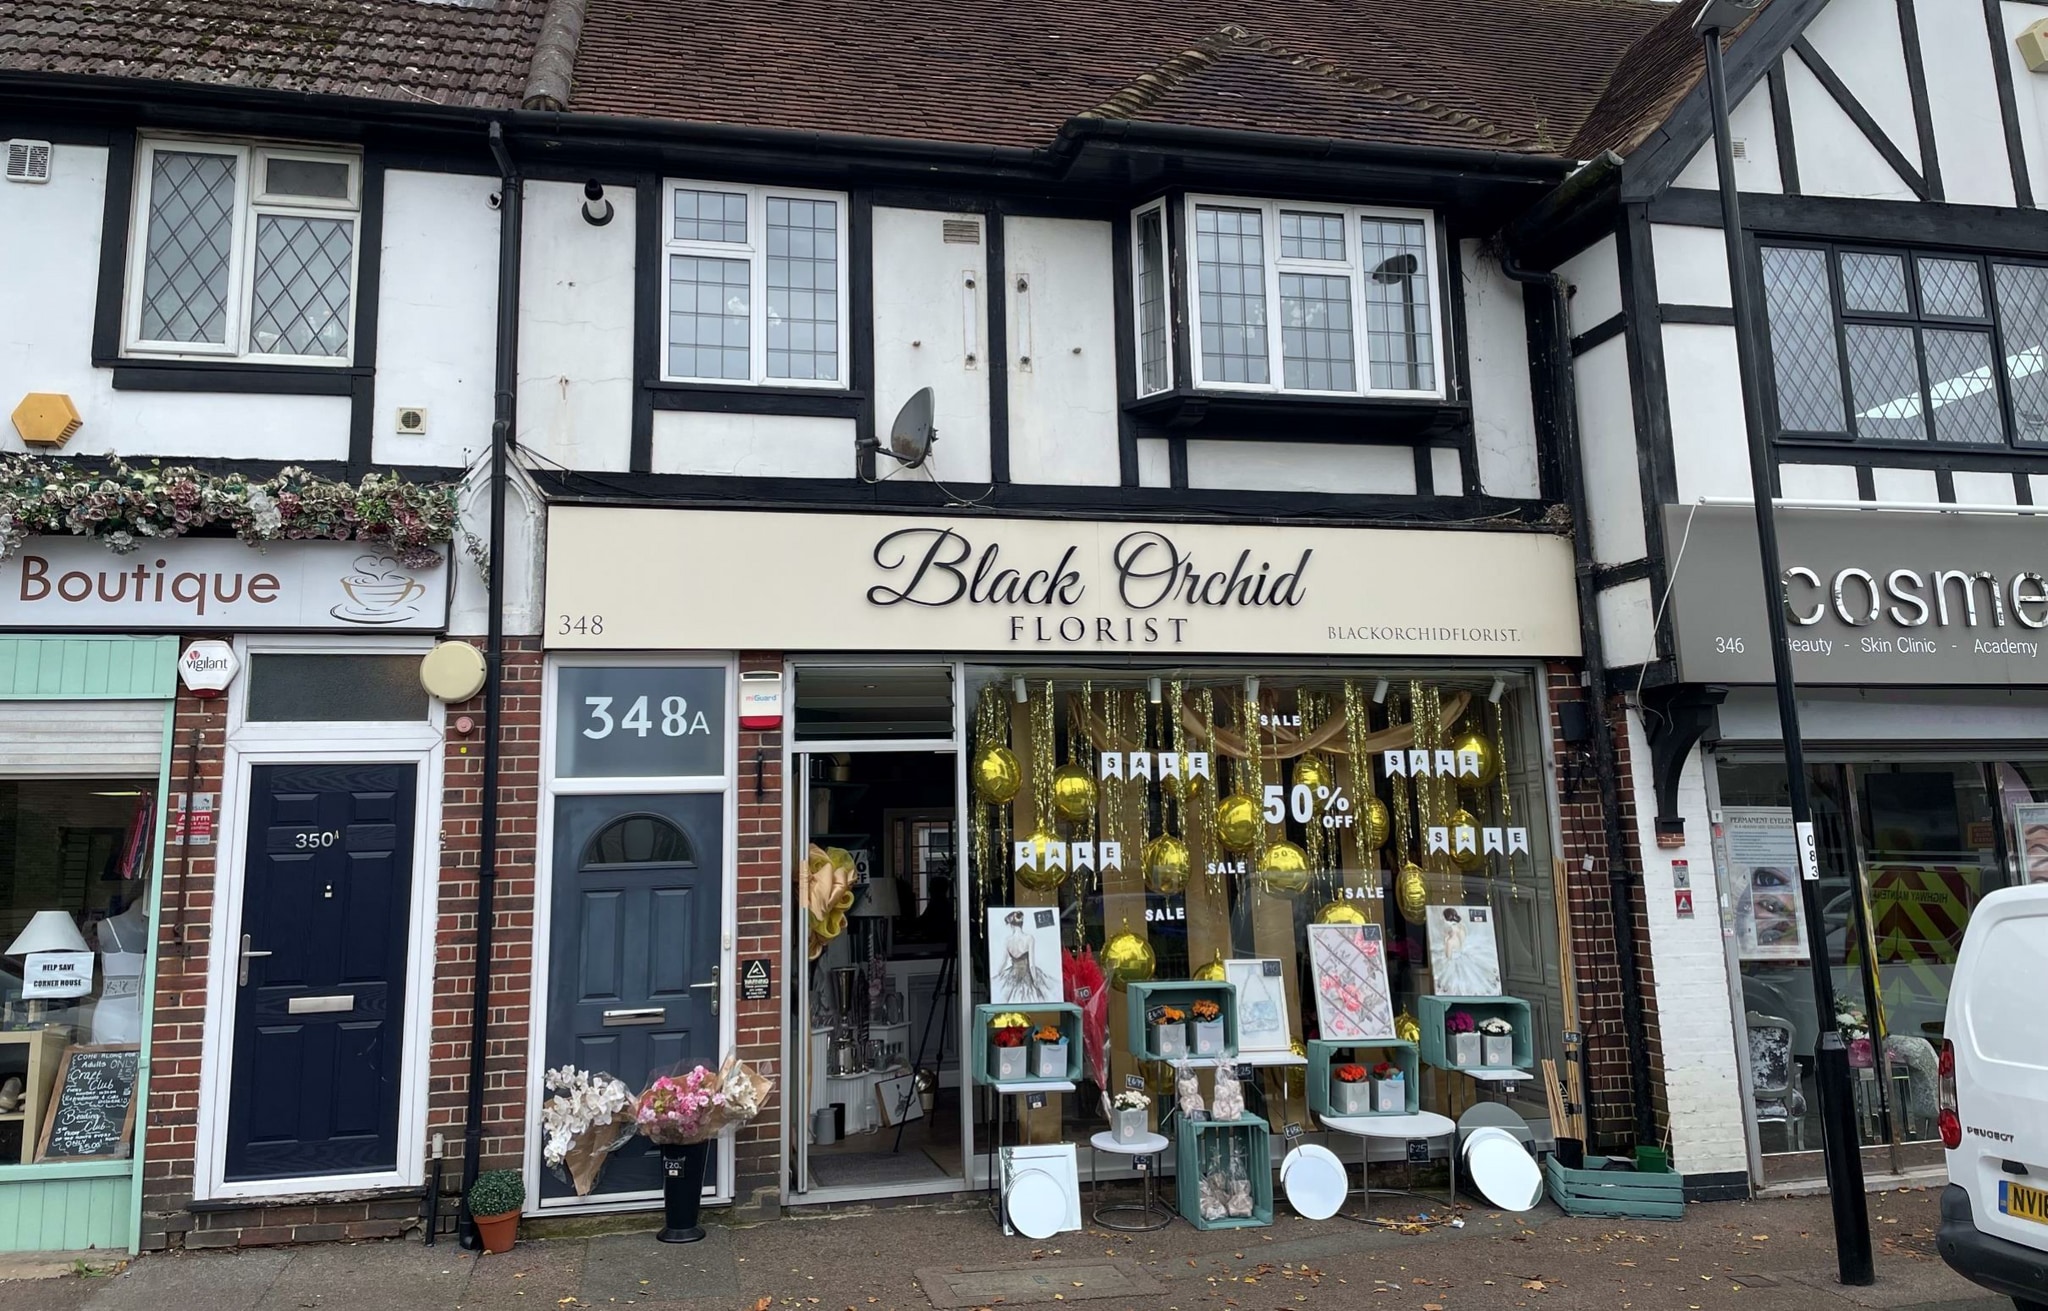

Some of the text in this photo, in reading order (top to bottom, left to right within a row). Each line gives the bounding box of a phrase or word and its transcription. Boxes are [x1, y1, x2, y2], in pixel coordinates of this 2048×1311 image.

[866, 526, 1314, 610] Black Orchid
[19, 555, 281, 616] Boutique
[558, 614, 604, 636] 348
[1009, 614, 1188, 644] FLORIST
[1327, 625, 1521, 642] BLACKORCHIDFLORIST.
[1715, 636, 1745, 654] 346
[1860, 636, 1892, 653] Skin
[1897, 636, 1936, 654] Clinic
[1974, 638, 2038, 657] Academy
[186, 656, 228, 672] vigilant
[745, 694, 777, 702] miGuard
[582, 695, 711, 740] 348A
[1260, 715, 1302, 727] SALE
[1107, 757, 1203, 769] SALE
[1390, 754, 1473, 766] SALE
[1263, 784, 1350, 825] 50%
[179, 814, 211, 822] Aarm
[1323, 815, 1353, 828] OFF
[1435, 831, 1522, 843] SALE
[1021, 847, 1115, 859] SALE
[1207, 862, 1246, 874] SALE
[1345, 887, 1385, 899] SALE
[1145, 907, 1186, 922] SALE
[42, 963, 75, 972] HELP SAVE
[33, 978, 82, 988] CORNER HOUSE
[89, 1079, 114, 1091] Club
[1966, 1126, 2015, 1144] PEUGEOT
